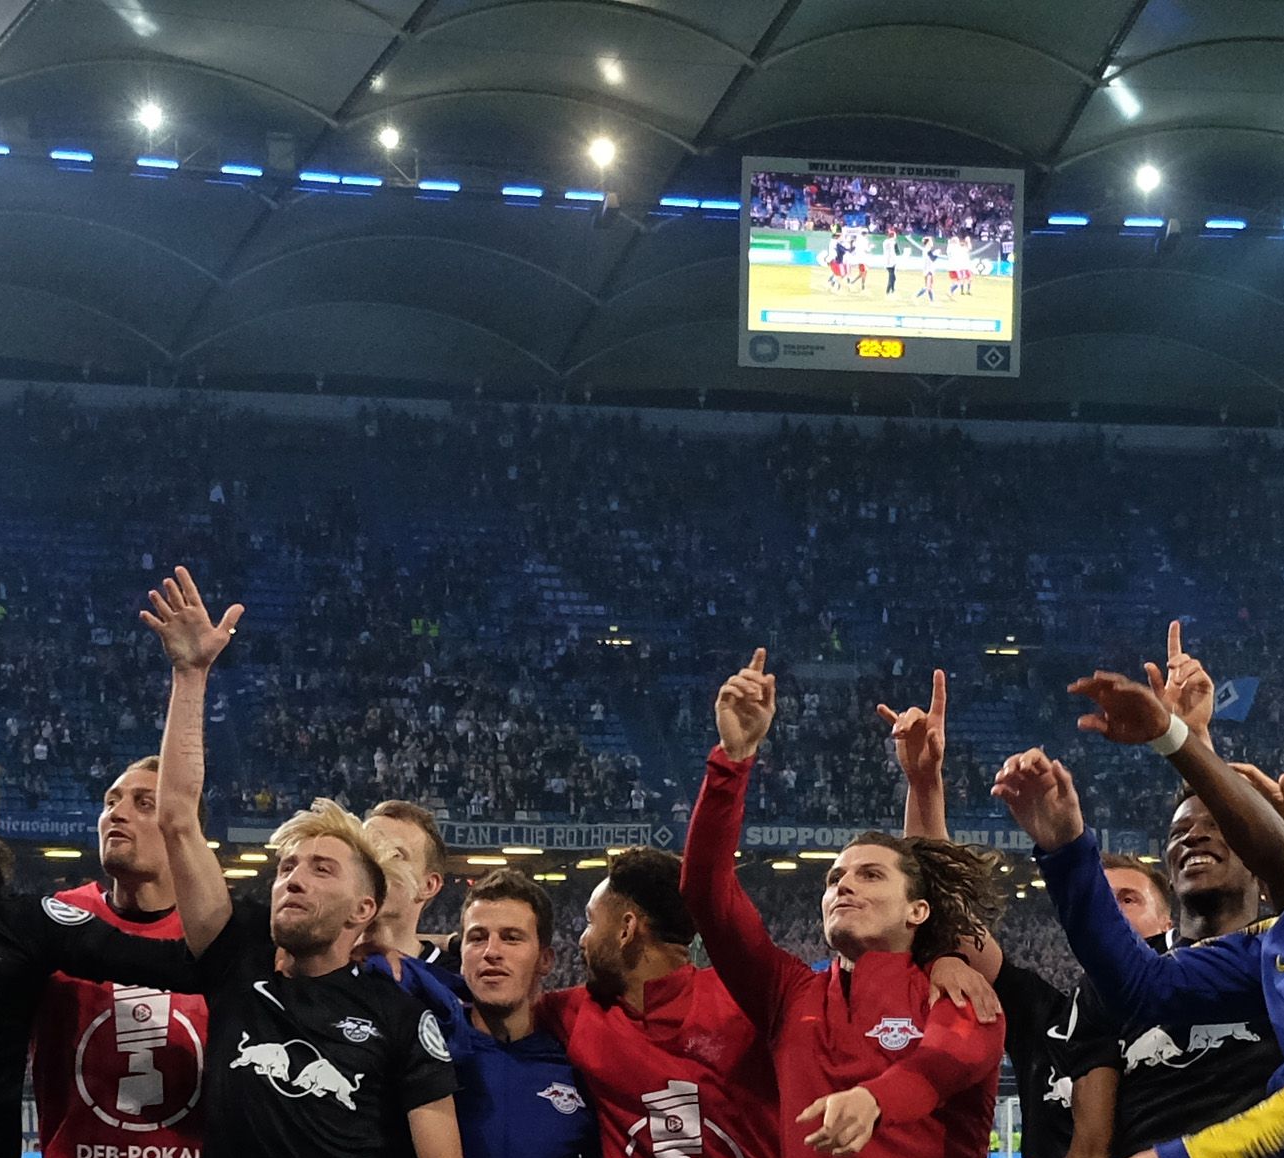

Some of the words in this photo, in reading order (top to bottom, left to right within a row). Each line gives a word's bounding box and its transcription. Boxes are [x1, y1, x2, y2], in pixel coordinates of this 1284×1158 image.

[455, 825, 491, 846] FAN
[498, 826, 549, 847] CLUB
[553, 826, 652, 848] ROTHOSEN
